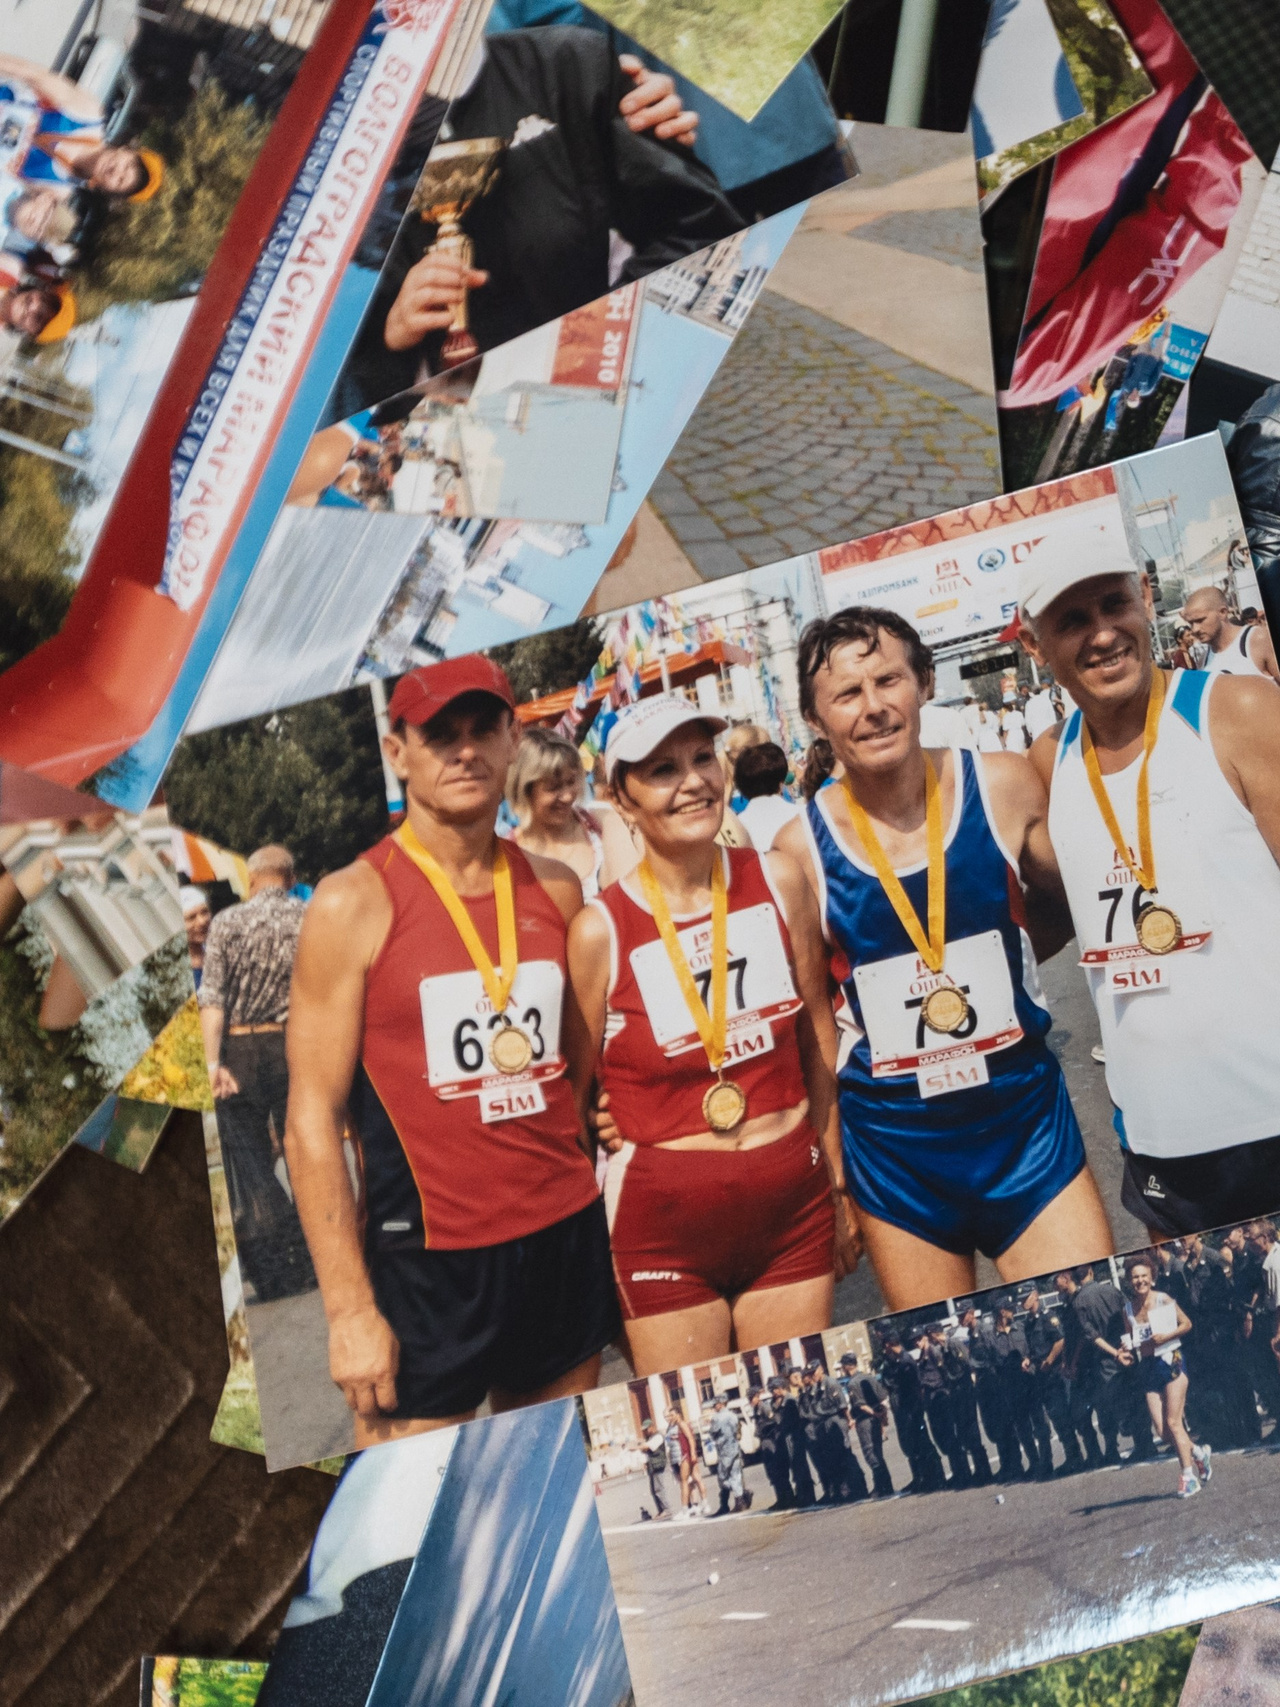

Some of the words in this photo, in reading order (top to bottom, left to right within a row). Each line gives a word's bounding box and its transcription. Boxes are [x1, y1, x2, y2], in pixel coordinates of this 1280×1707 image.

[247, 54, 411, 385] ВОЛГОГРАДСКИЙ
[597, 329, 622, 383] 2010
[187, 372, 229, 434] ВСЕХ
[693, 957, 748, 1010] 77
[918, 1044, 976, 1067] МАРАФОН
